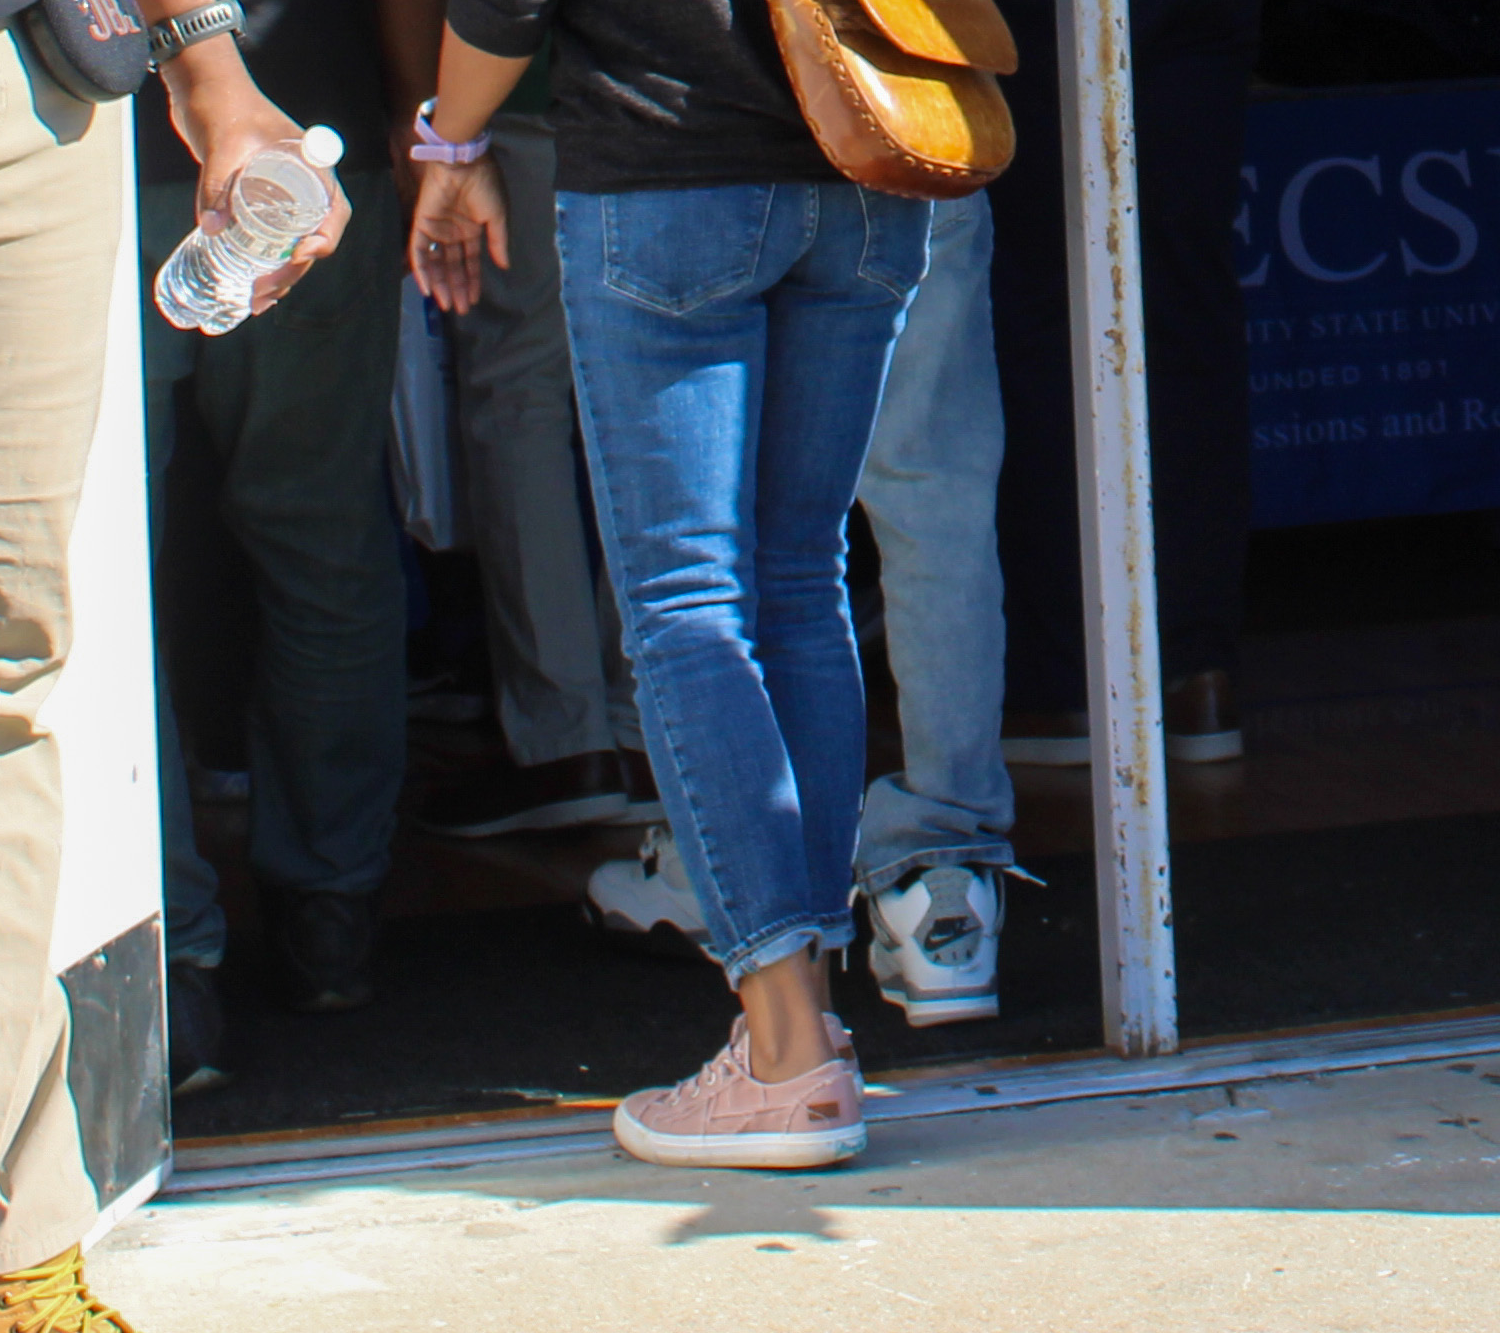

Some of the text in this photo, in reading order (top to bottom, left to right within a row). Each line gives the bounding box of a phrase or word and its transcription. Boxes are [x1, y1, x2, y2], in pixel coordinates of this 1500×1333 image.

[1244, 318, 1297, 345] ITY
[1309, 307, 1410, 339] STATE
[1248, 359, 1451, 395] UNDED 1891
[1252, 411, 1368, 451] ssions
[1382, 399, 1448, 440] and
